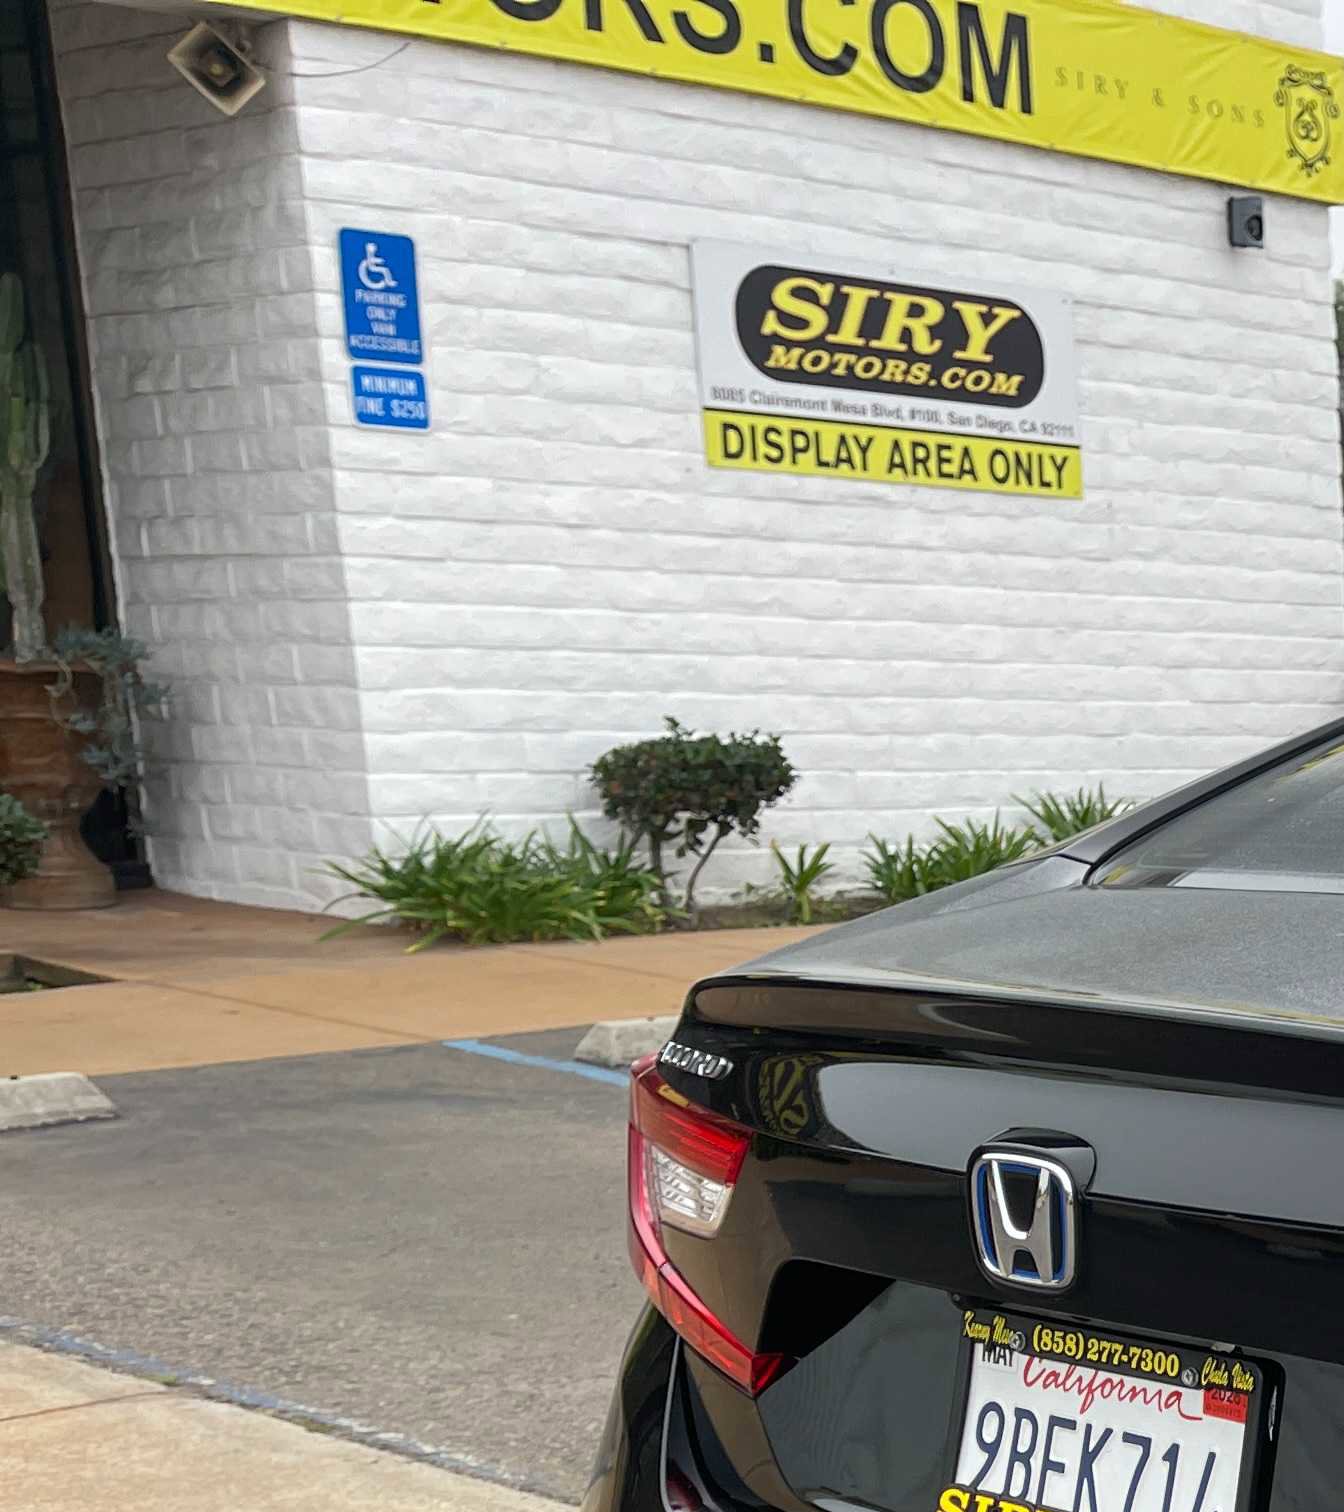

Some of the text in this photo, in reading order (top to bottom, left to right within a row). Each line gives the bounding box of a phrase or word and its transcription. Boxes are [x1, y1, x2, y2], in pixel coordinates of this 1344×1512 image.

[1055, 66, 1128, 99] SIRY
[1188, 95, 1264, 128] SONS
[760, 276, 1022, 363] SIRY
[360, 375, 417, 397] MINIMUM
[764, 344, 1025, 396] MOTORS.COM
[722, 423, 1068, 489] DISPLAY AREA ONLY
[982, 1342, 1015, 1367] MAY
[1024, 1356, 1202, 1420] California
